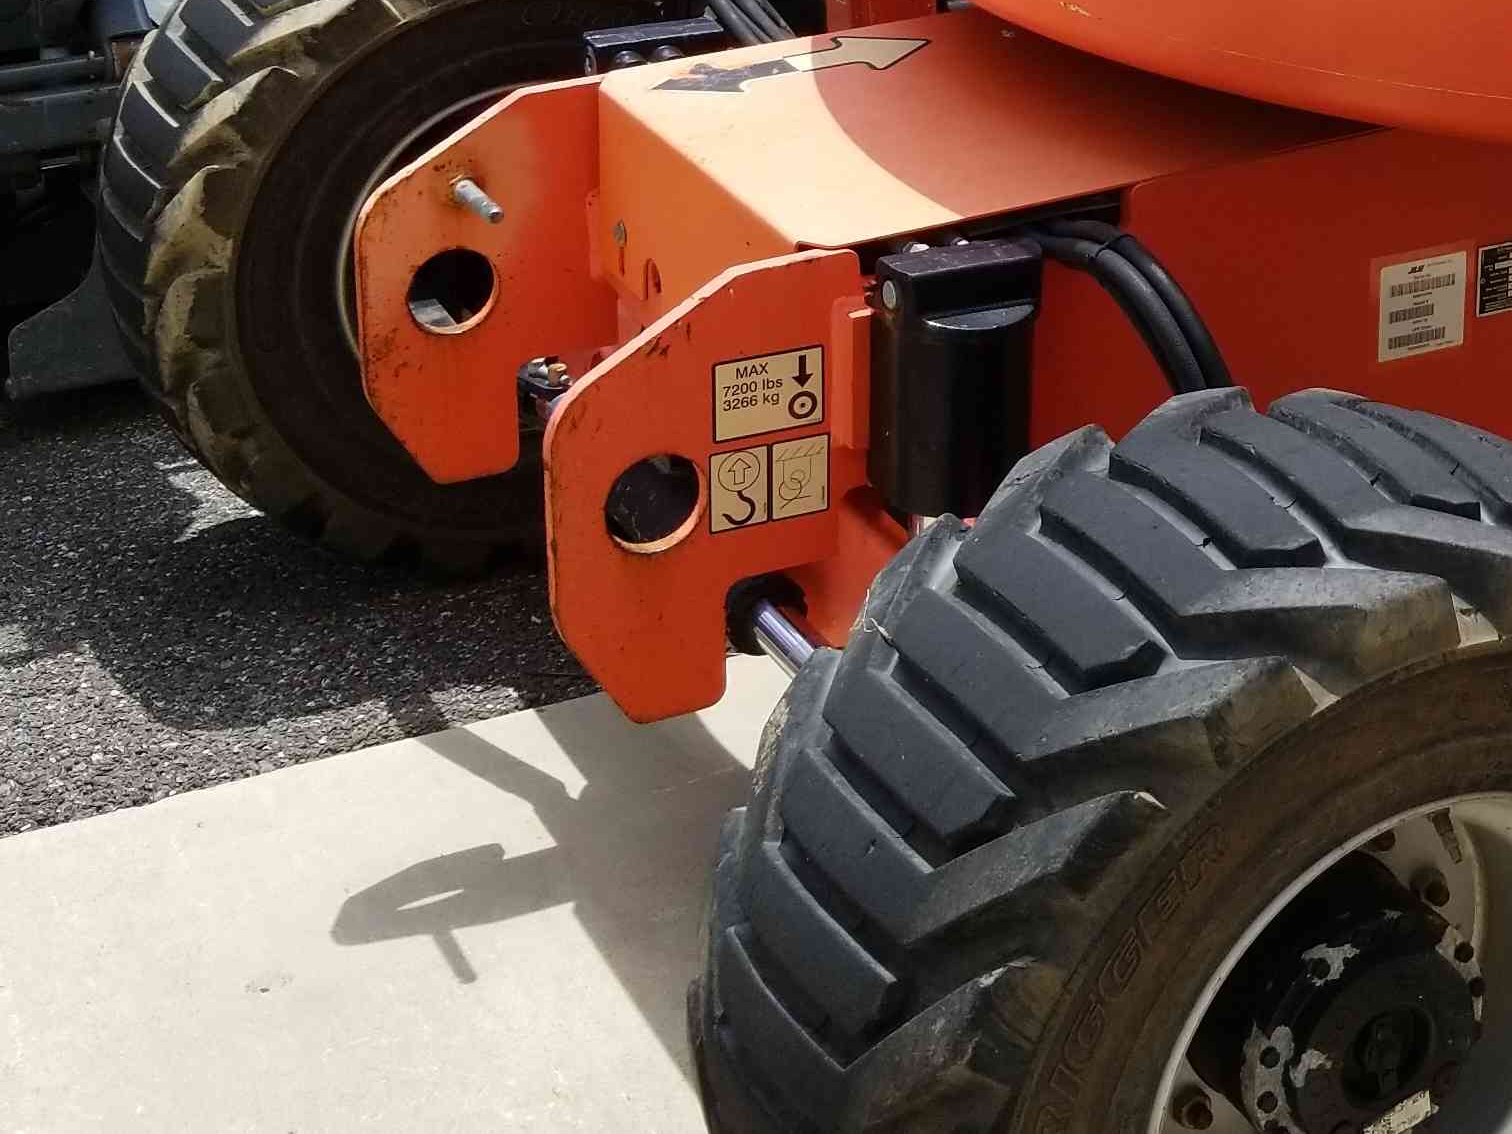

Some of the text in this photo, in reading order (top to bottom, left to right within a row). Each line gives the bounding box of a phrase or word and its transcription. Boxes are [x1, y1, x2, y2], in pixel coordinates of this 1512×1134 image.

[735, 361, 769, 381] MAX
[722, 377, 783, 399] 7200 lbs
[722, 391, 780, 412] 3266 kg
